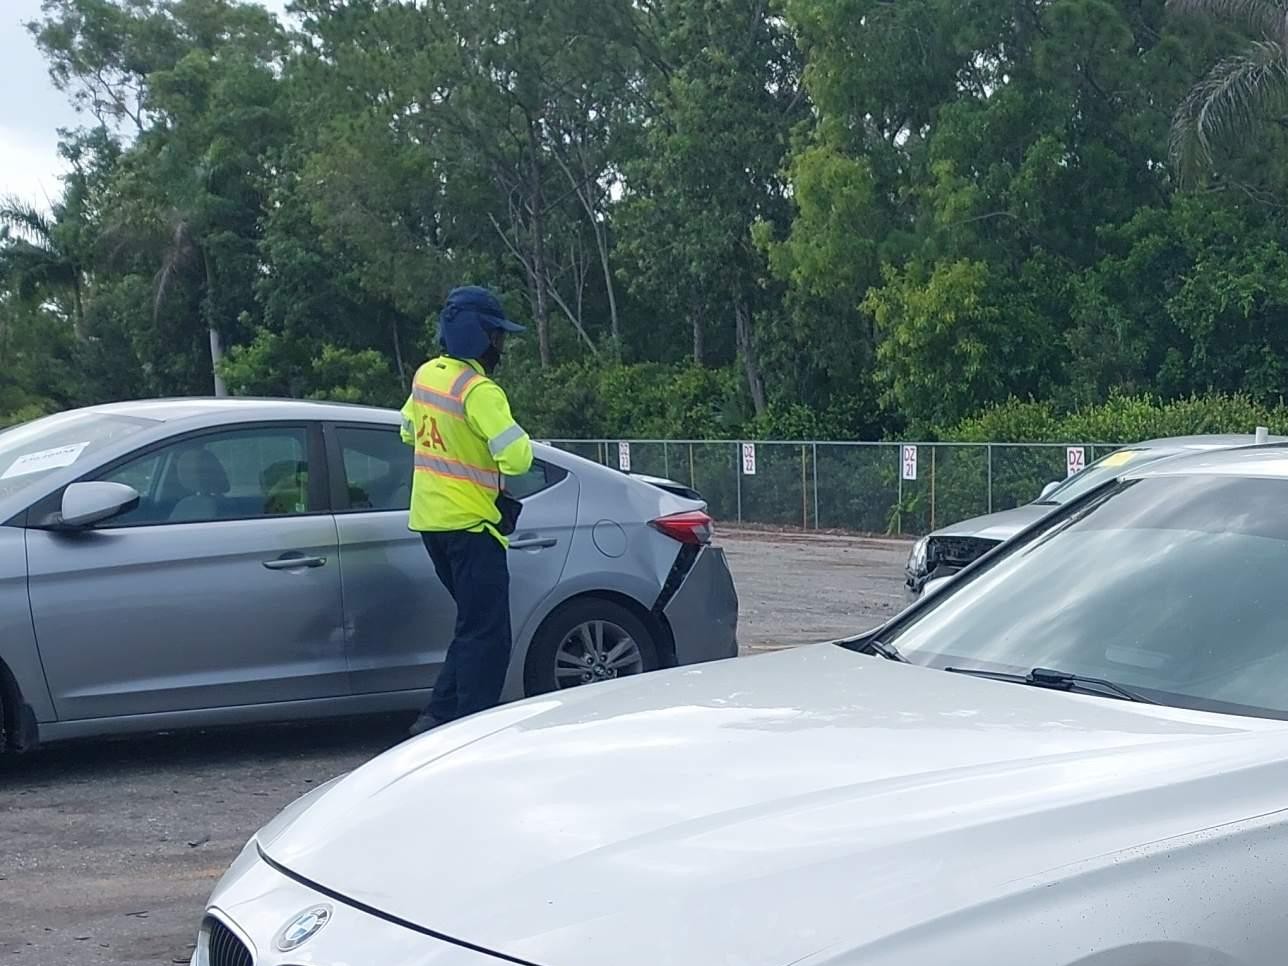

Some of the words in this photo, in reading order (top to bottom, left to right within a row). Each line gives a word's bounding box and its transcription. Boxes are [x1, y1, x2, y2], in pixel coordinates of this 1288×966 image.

[744, 445, 754, 457] DZ
[904, 447, 916, 461] DZ
[1068, 450, 1083, 465] DZ
[906, 463, 914, 476] 21
